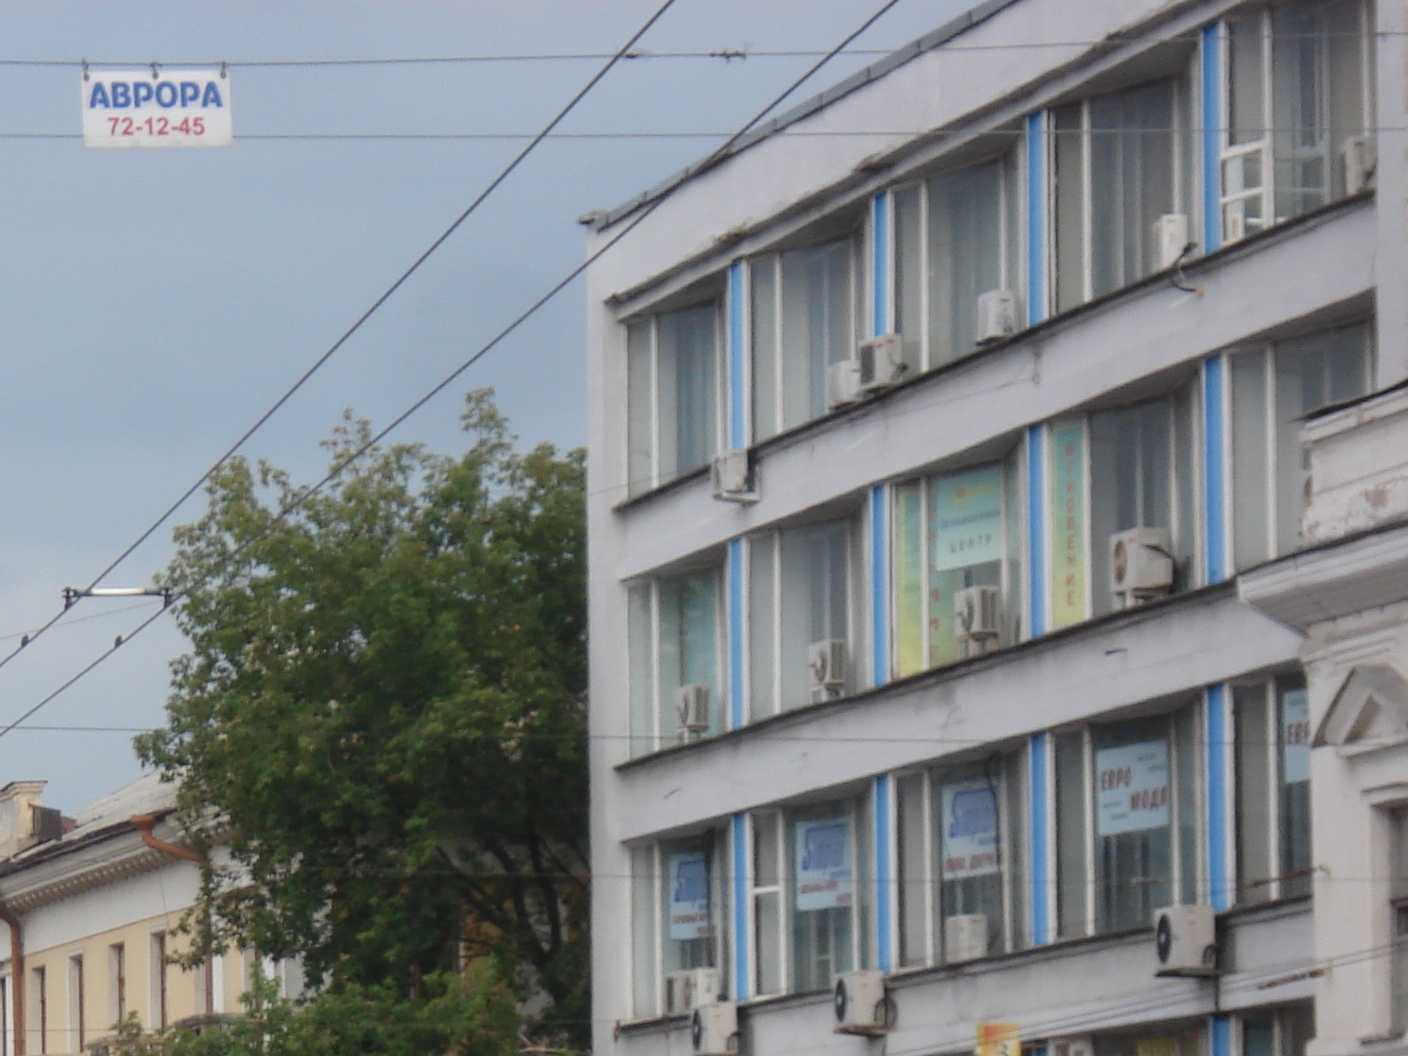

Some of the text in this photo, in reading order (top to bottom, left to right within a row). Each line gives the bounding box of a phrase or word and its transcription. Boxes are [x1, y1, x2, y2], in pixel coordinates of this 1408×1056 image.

[89, 81, 223, 109] АВРОРА
[107, 117, 206, 136] 72-12-45
[1100, 765, 1133, 791] ЕВРО
